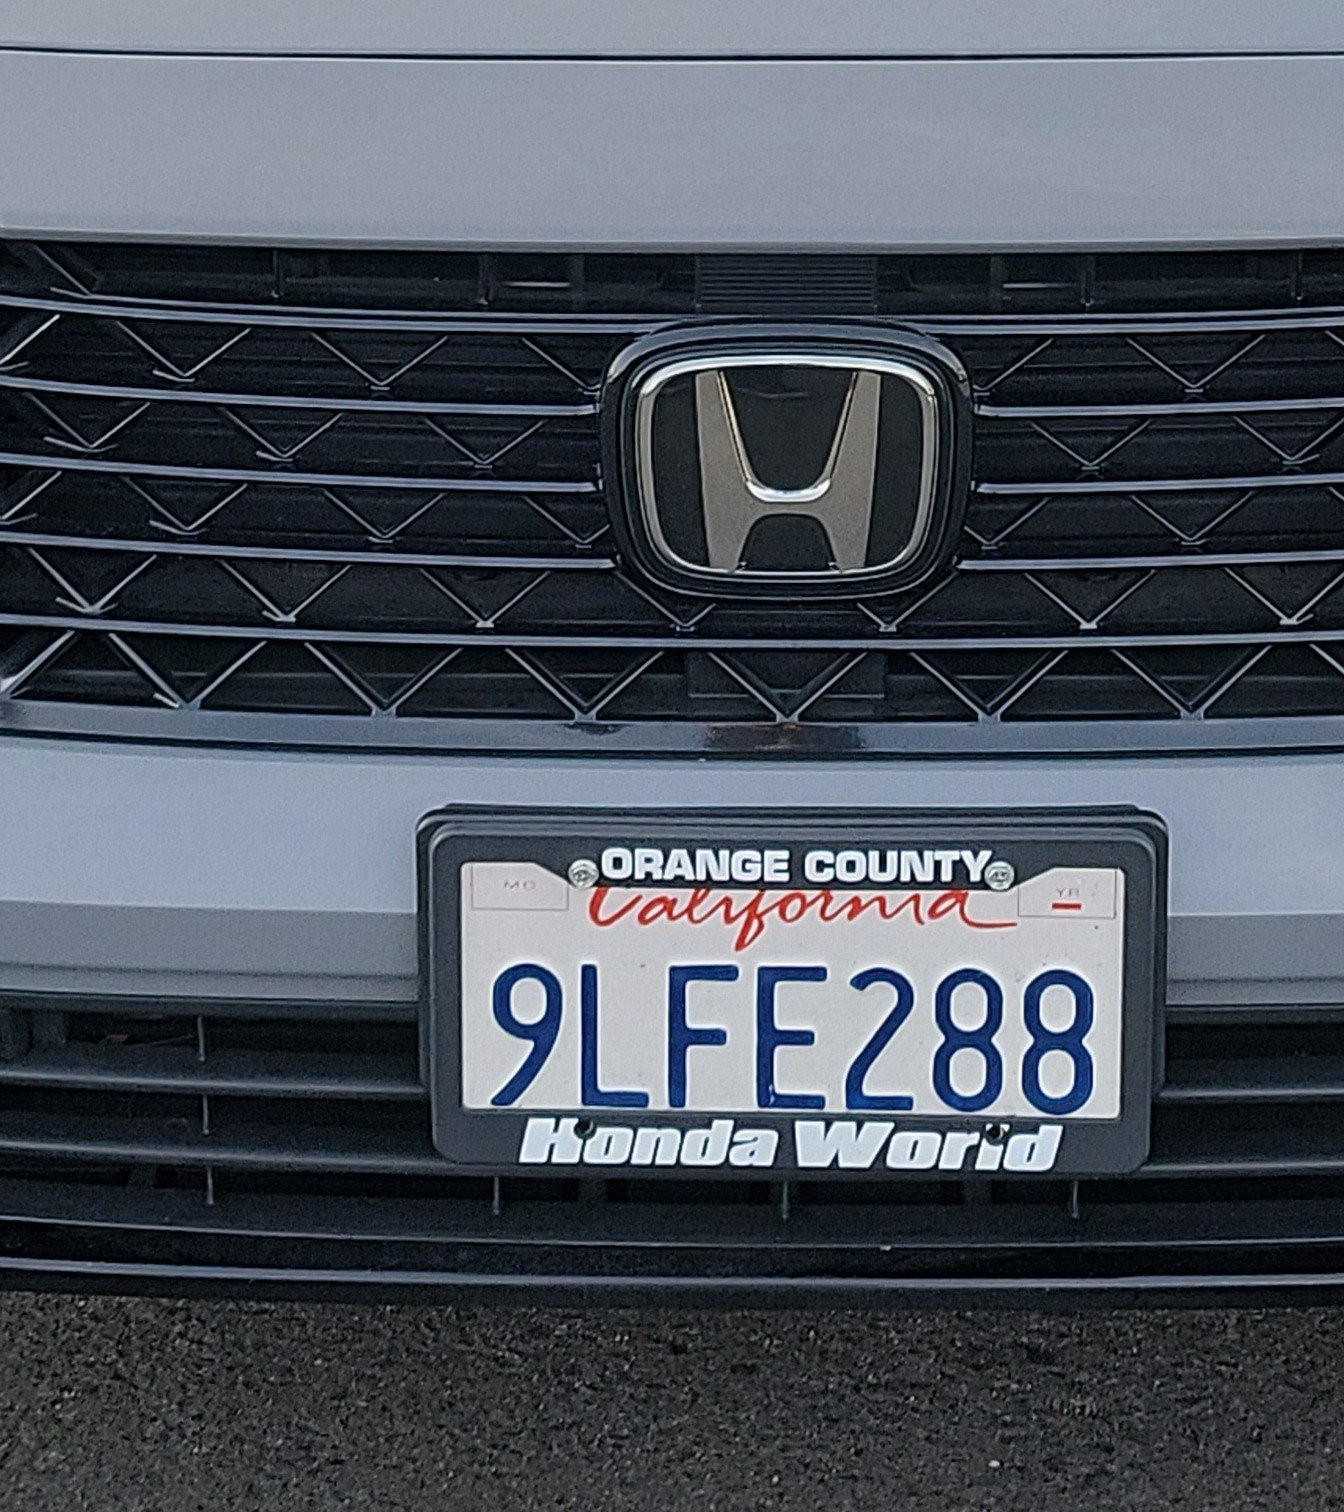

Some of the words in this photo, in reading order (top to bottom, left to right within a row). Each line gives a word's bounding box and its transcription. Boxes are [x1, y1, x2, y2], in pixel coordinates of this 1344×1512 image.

[601, 848, 792, 883] ORANGE
[803, 849, 993, 884] COUNTY
[588, 885, 1018, 952] California
[490, 962, 1095, 1116] 9LFE288
[518, 1117, 779, 1170] Honda
[793, 1121, 1064, 1174] World
